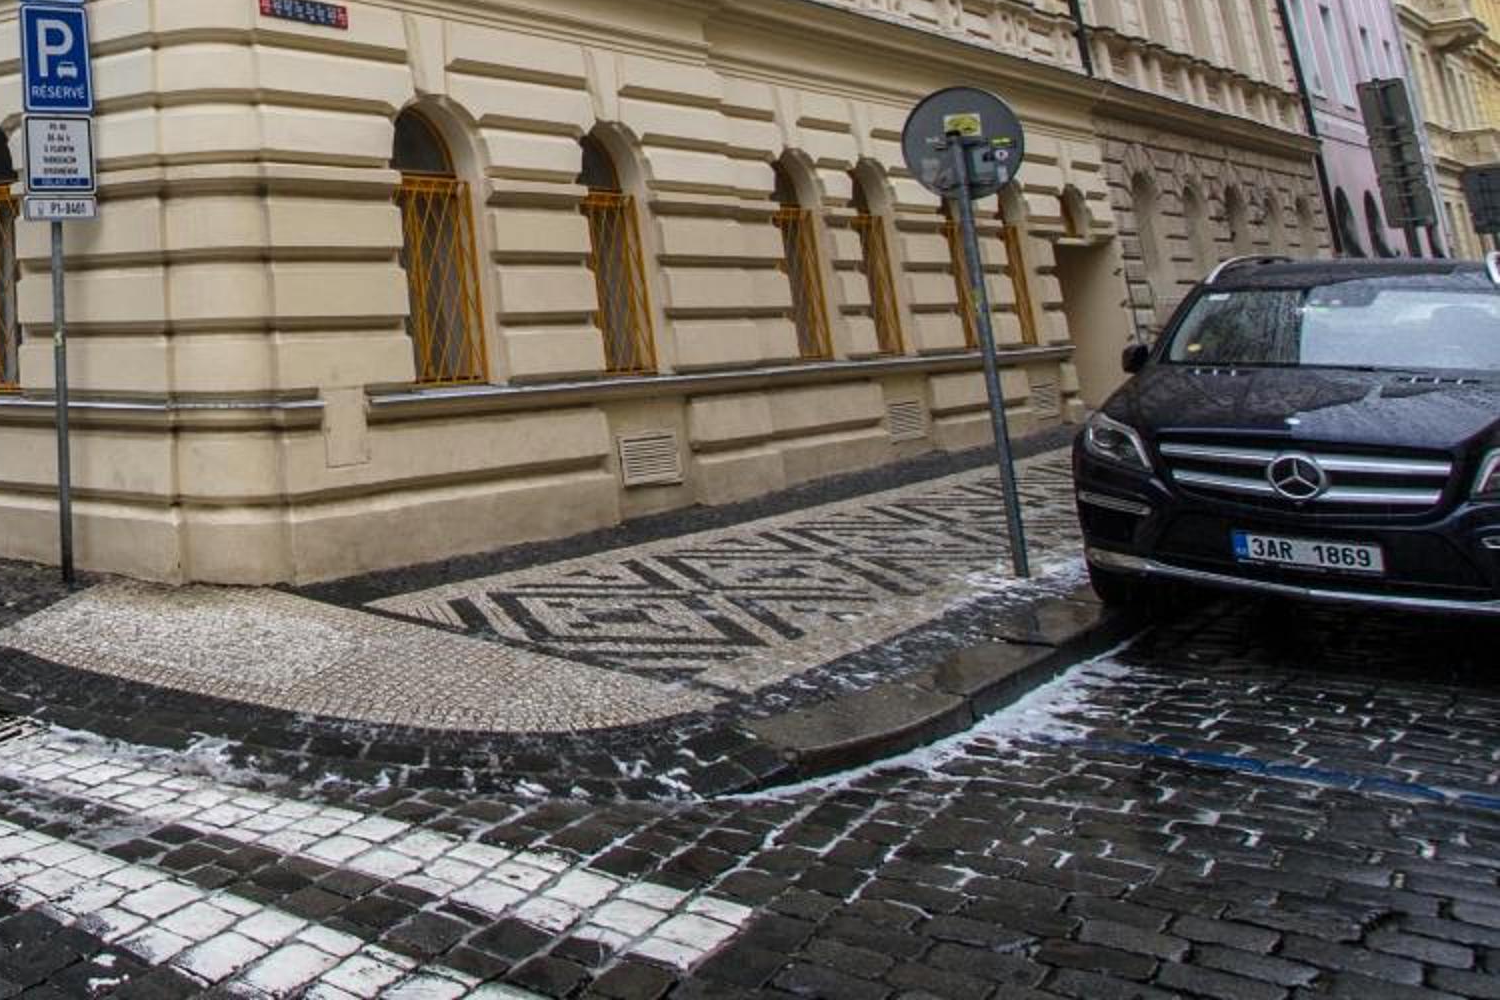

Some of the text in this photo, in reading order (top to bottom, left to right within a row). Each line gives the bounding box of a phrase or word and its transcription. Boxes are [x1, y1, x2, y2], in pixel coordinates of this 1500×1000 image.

[36, 18, 74, 77] P
[1251, 537, 1372, 567] 3AR 1869
